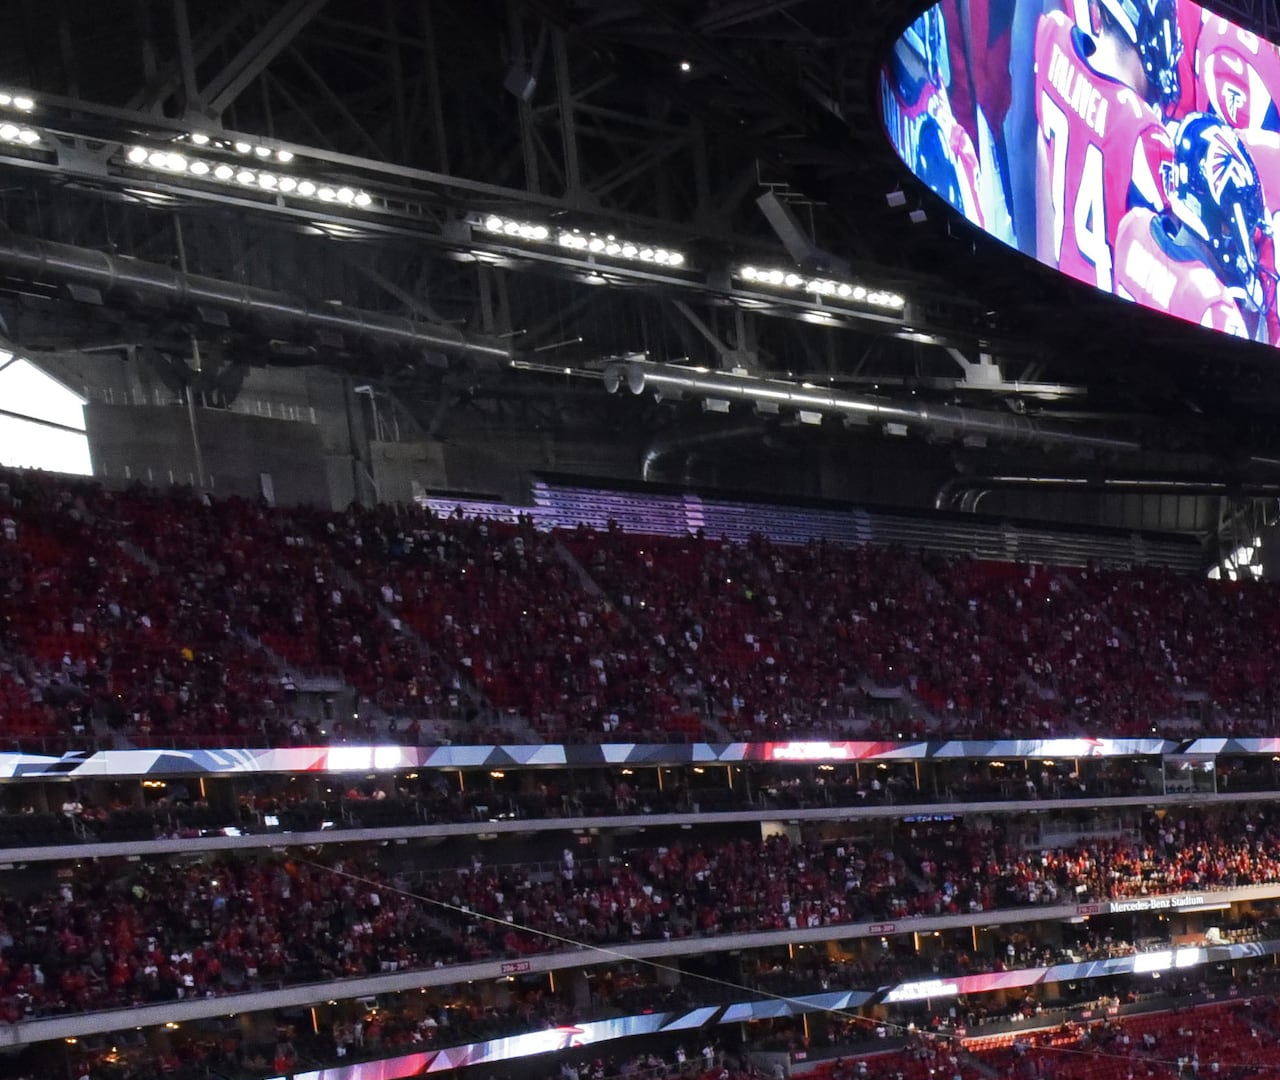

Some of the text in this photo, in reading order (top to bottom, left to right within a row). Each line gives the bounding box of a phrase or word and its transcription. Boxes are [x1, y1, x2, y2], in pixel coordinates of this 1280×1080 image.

[1041, 90, 1114, 294] 74
[1110, 895, 1204, 913] Mercedes-Benz Stadium
